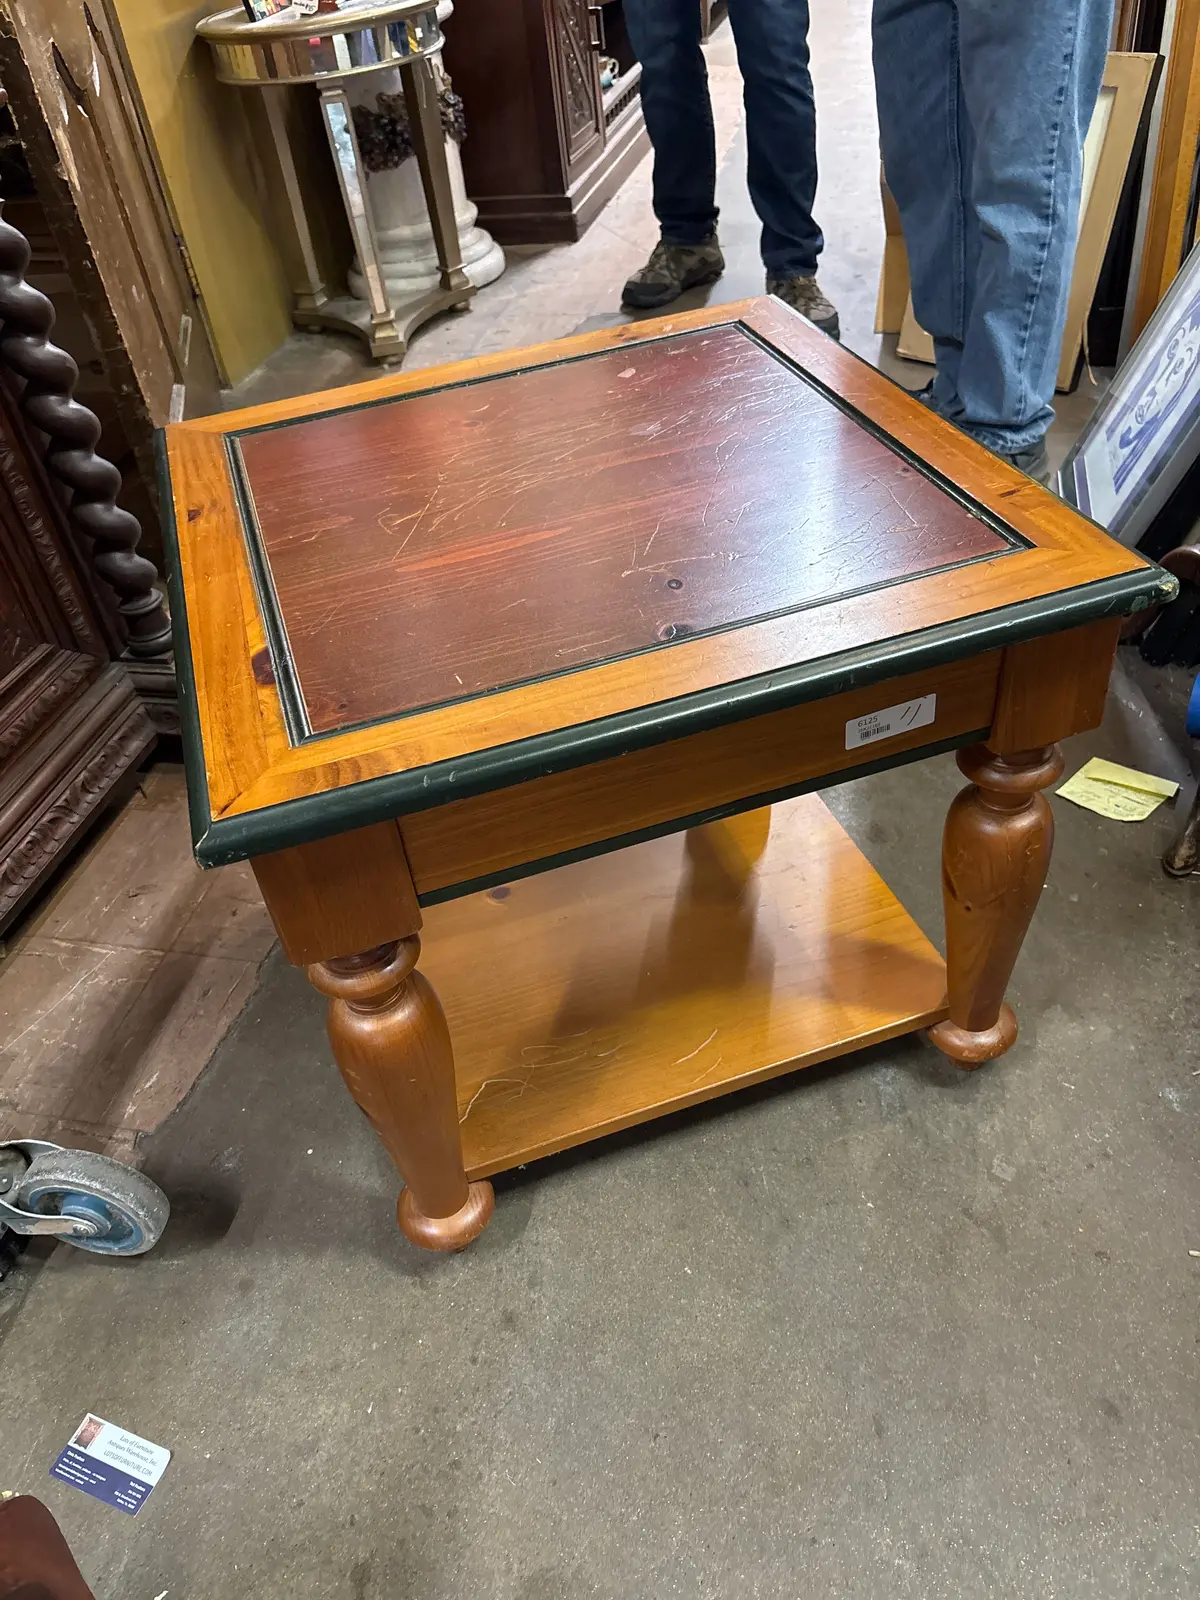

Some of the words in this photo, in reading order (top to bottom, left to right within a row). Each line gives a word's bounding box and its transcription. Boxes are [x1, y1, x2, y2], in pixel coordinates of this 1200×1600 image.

[857, 715, 878, 727] 6125
[107, 1439, 126, 1452] Antiques
[149, 1458, 158, 1467] Inc.
[120, 1435, 129, 1444] Lots
[134, 1441, 155, 1455] Furniture
[103, 1449, 153, 1477] LOTSOFFURNITURE.COM
